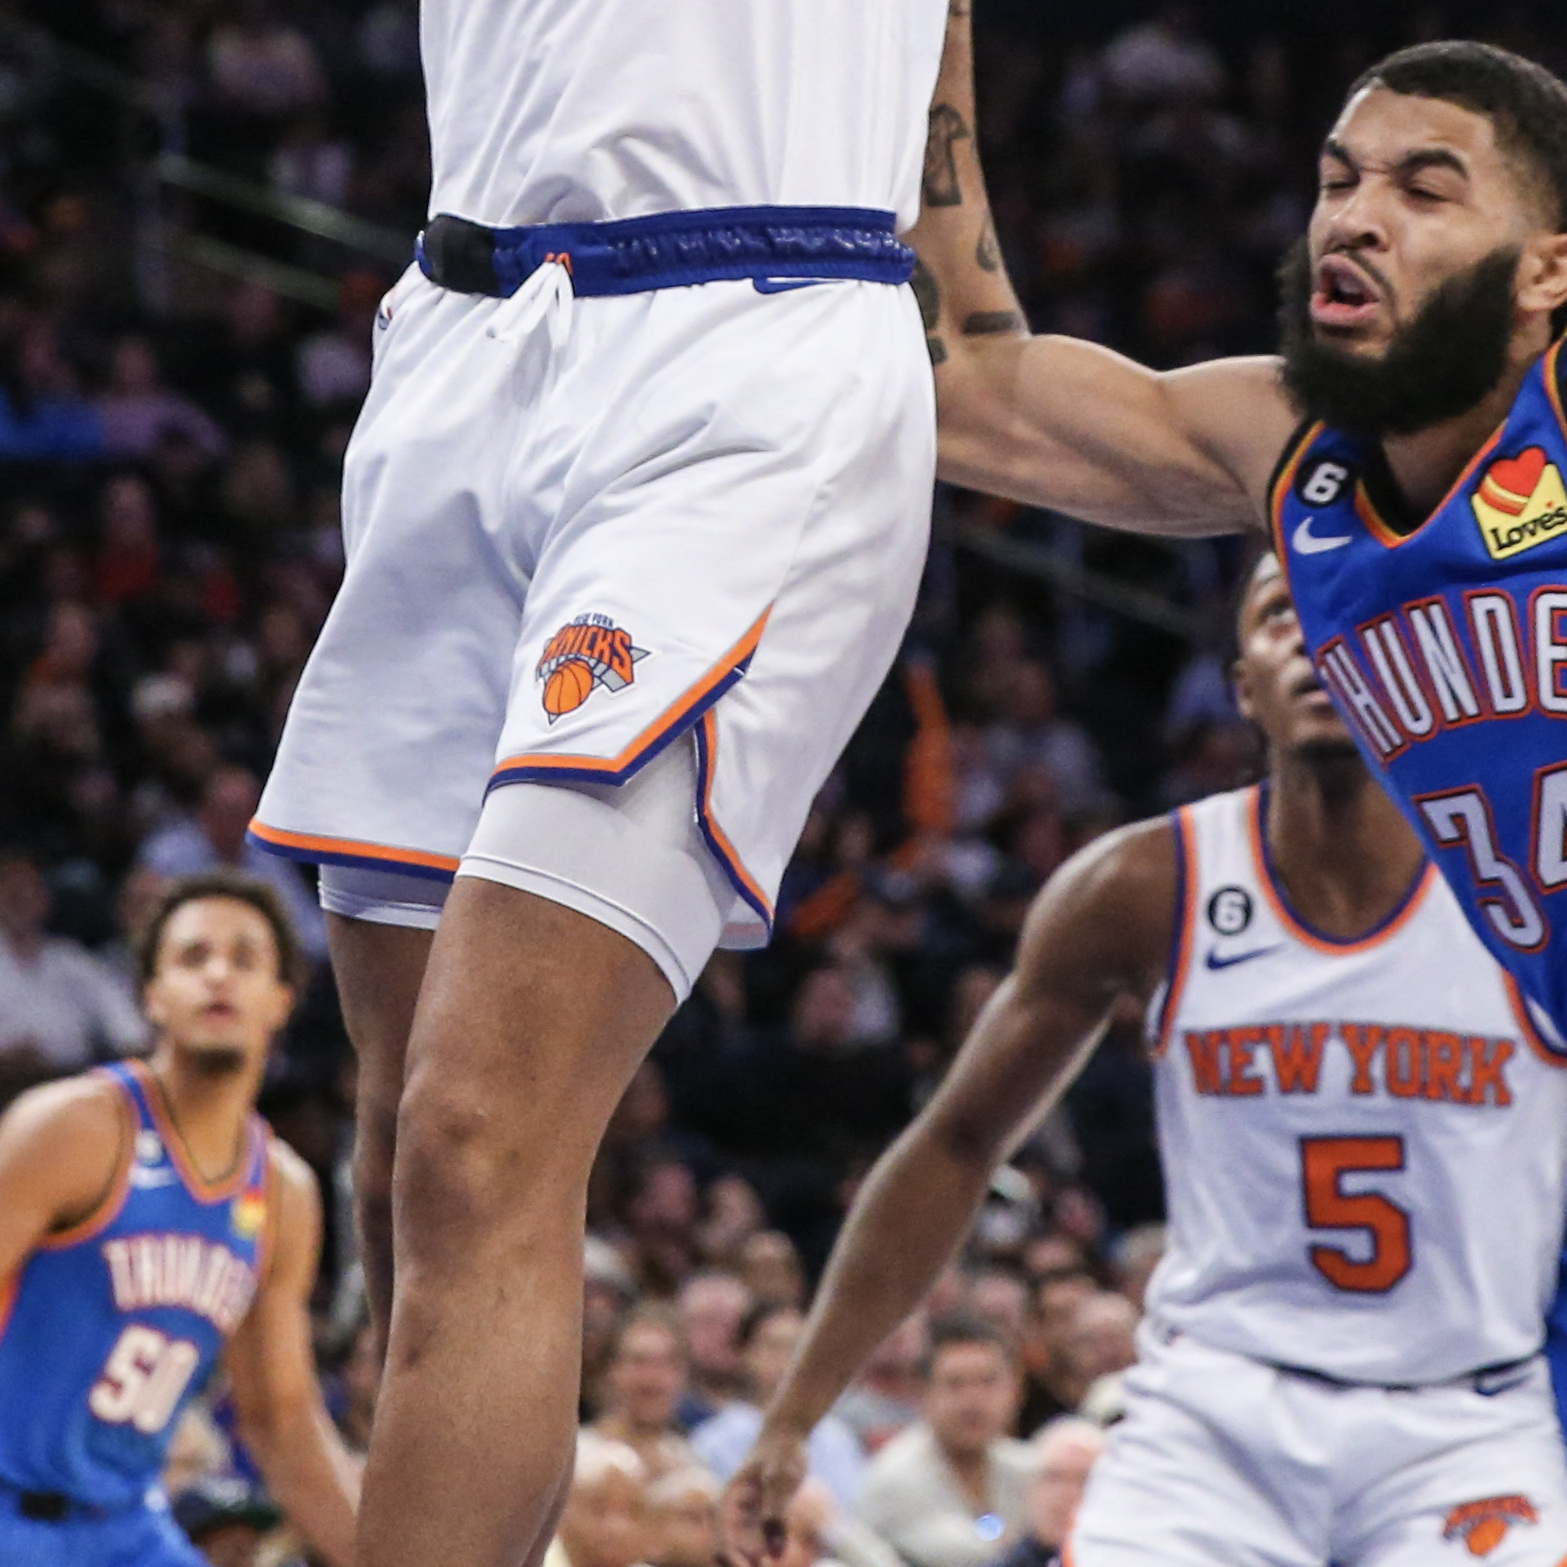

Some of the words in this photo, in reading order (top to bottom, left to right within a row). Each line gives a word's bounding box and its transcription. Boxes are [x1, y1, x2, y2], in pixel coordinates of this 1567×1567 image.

[1303, 461, 1348, 503] 6
[1213, 891, 1249, 930] 6
[1184, 1021, 1330, 1097] NEW
[1337, 1021, 1516, 1108] YORK
[1298, 1133, 1414, 1298] 5
